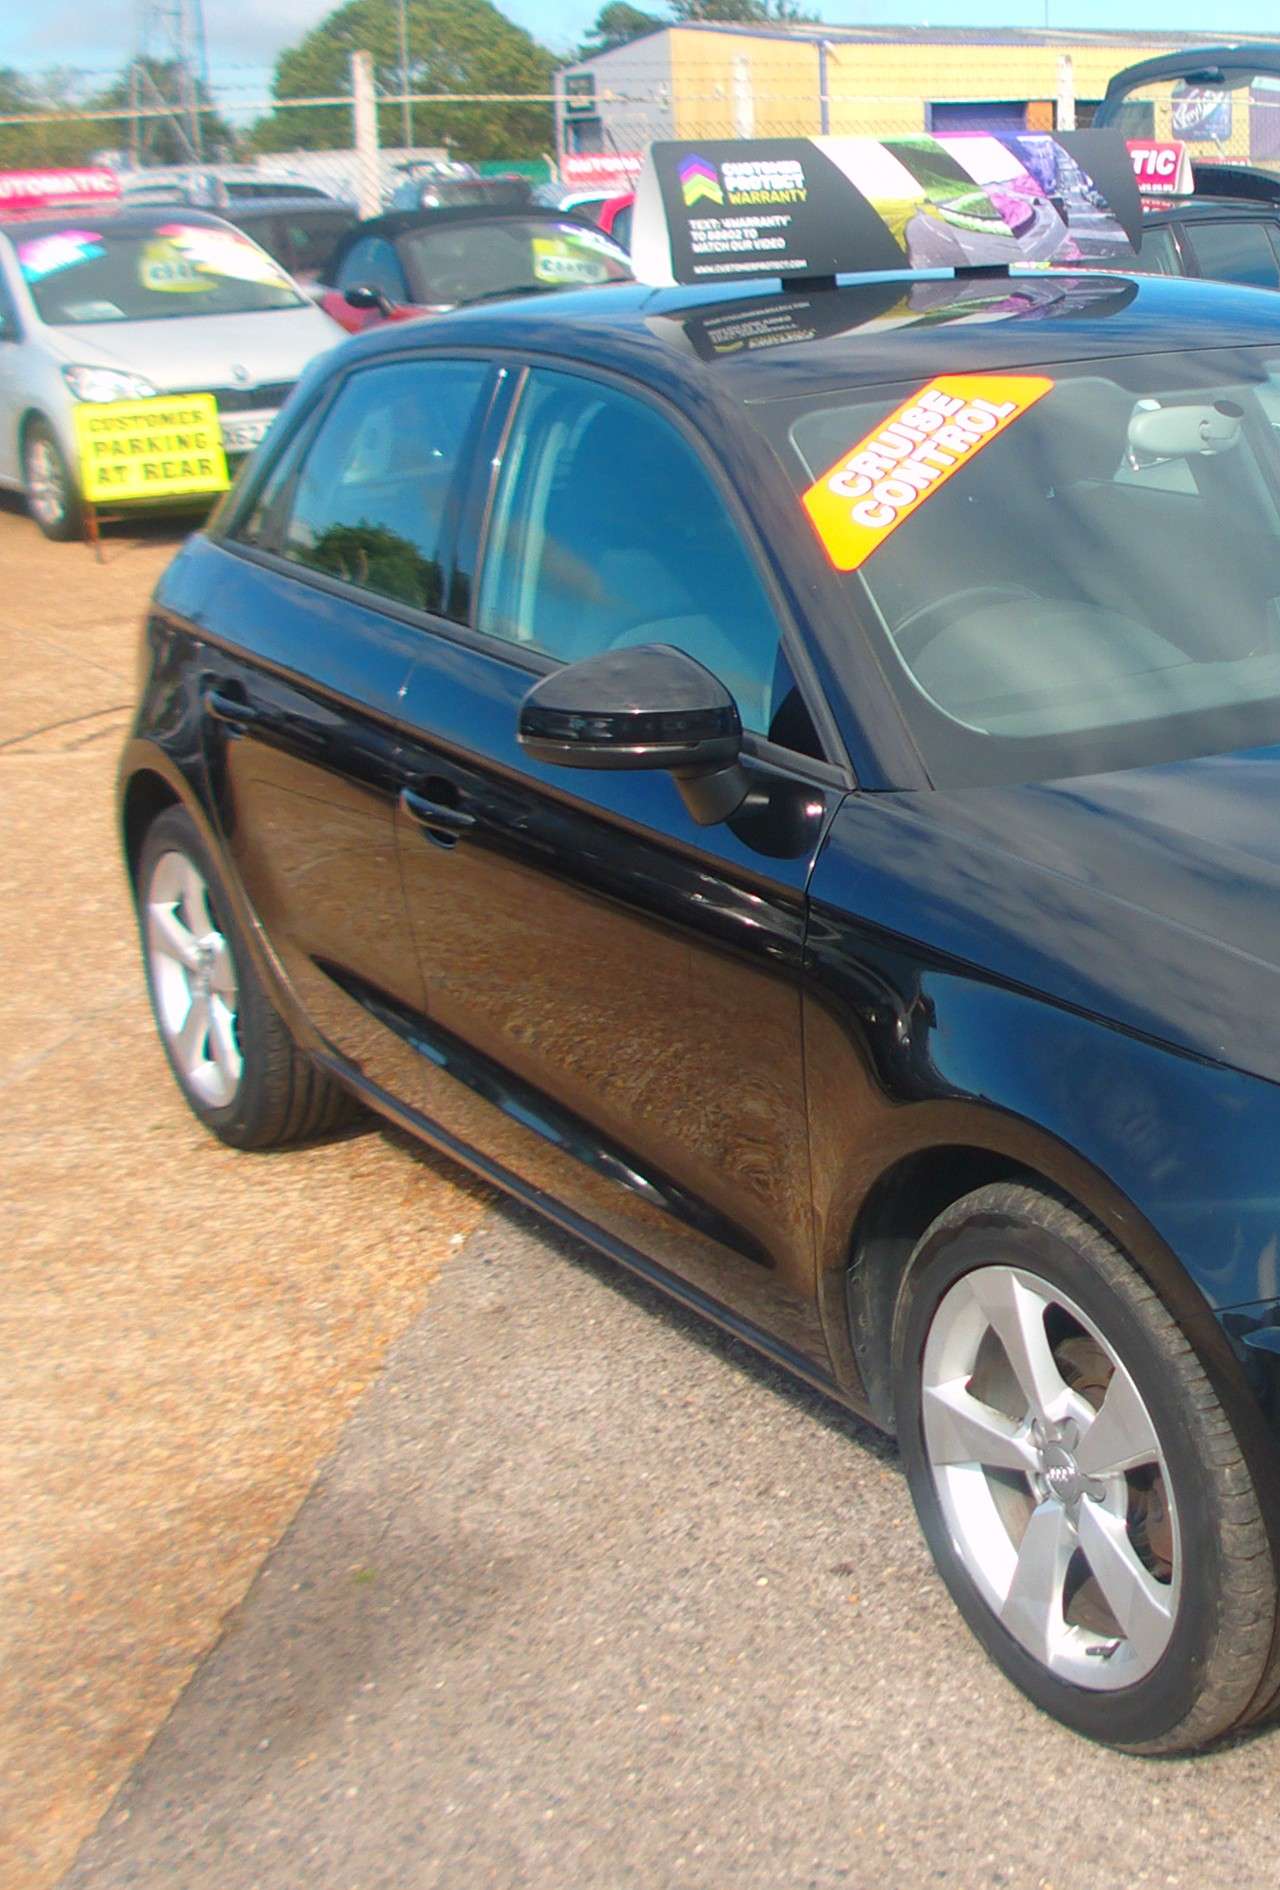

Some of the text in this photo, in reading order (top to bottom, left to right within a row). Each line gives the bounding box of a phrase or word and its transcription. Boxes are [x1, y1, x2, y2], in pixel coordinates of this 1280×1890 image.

[728, 188, 807, 205] WARRANTY
[89, 410, 204, 432] CUSTOMER
[93, 432, 208, 456] PARKING
[828, 390, 967, 498] CRUISE
[98, 457, 214, 485] AT REAR
[851, 397, 1019, 528] CONTROL
